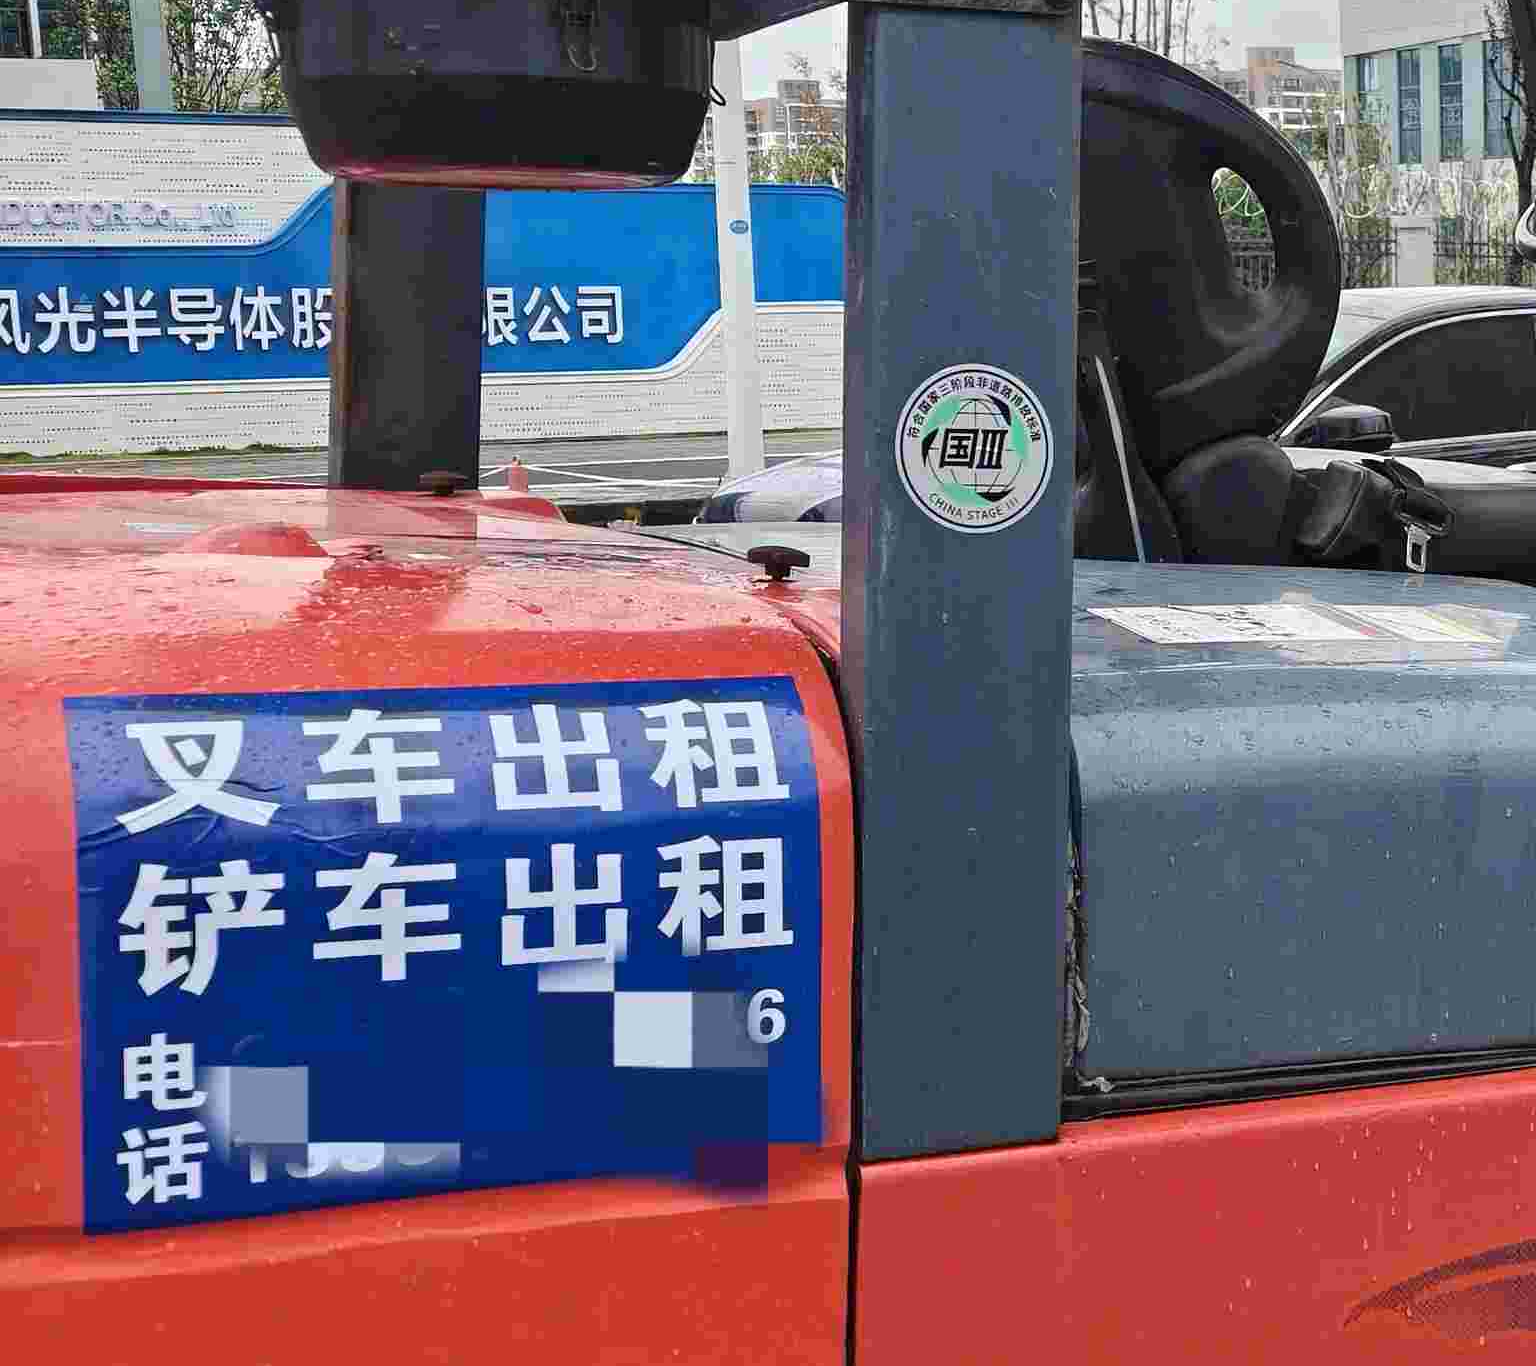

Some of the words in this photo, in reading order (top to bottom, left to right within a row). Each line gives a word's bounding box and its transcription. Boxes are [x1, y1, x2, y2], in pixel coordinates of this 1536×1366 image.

[927, 492, 963, 519] CHINA
[967, 506, 1007, 522] STAGE
[115, 698, 792, 835] 叉车出租
[117, 835, 795, 997] 铲车出租
[115, 1033, 210, 1205] 电话
